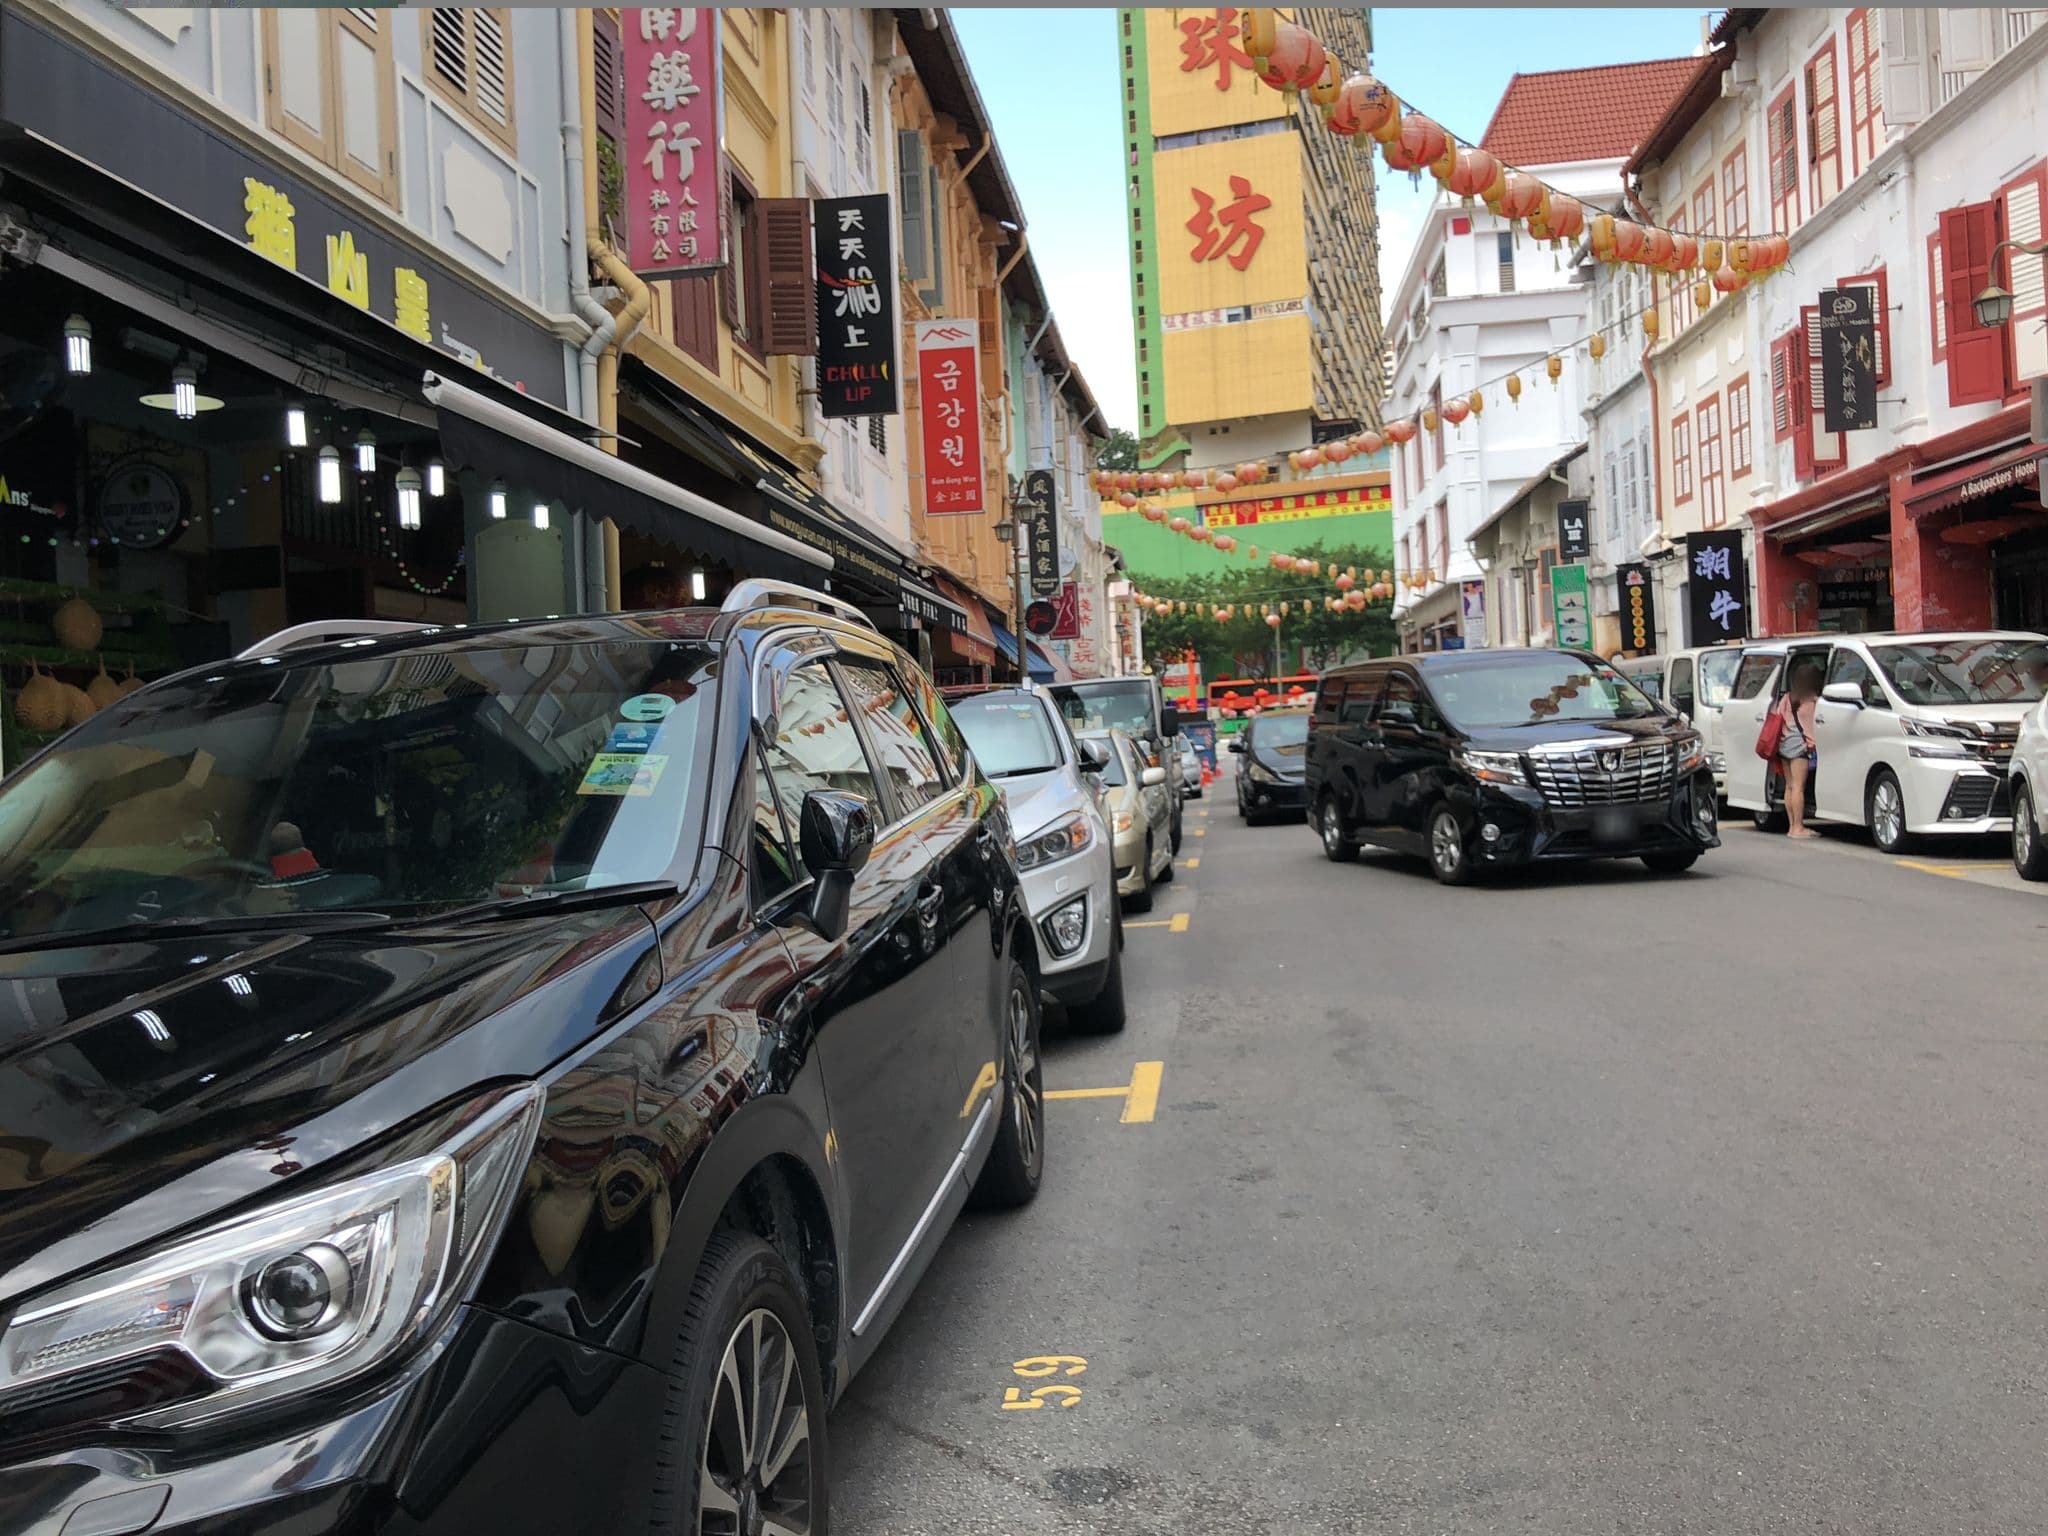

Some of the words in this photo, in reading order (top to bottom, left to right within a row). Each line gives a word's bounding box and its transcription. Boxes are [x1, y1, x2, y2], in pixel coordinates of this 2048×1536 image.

[845, 386, 873, 402] UP
[933, 359, 966, 467] 금강원
[1960, 484, 1969, 498] A
[2014, 459, 2037, 479] Hotel
[1693, 545, 1742, 631] 潮牛
[1001, 1355, 1088, 1410] 59
